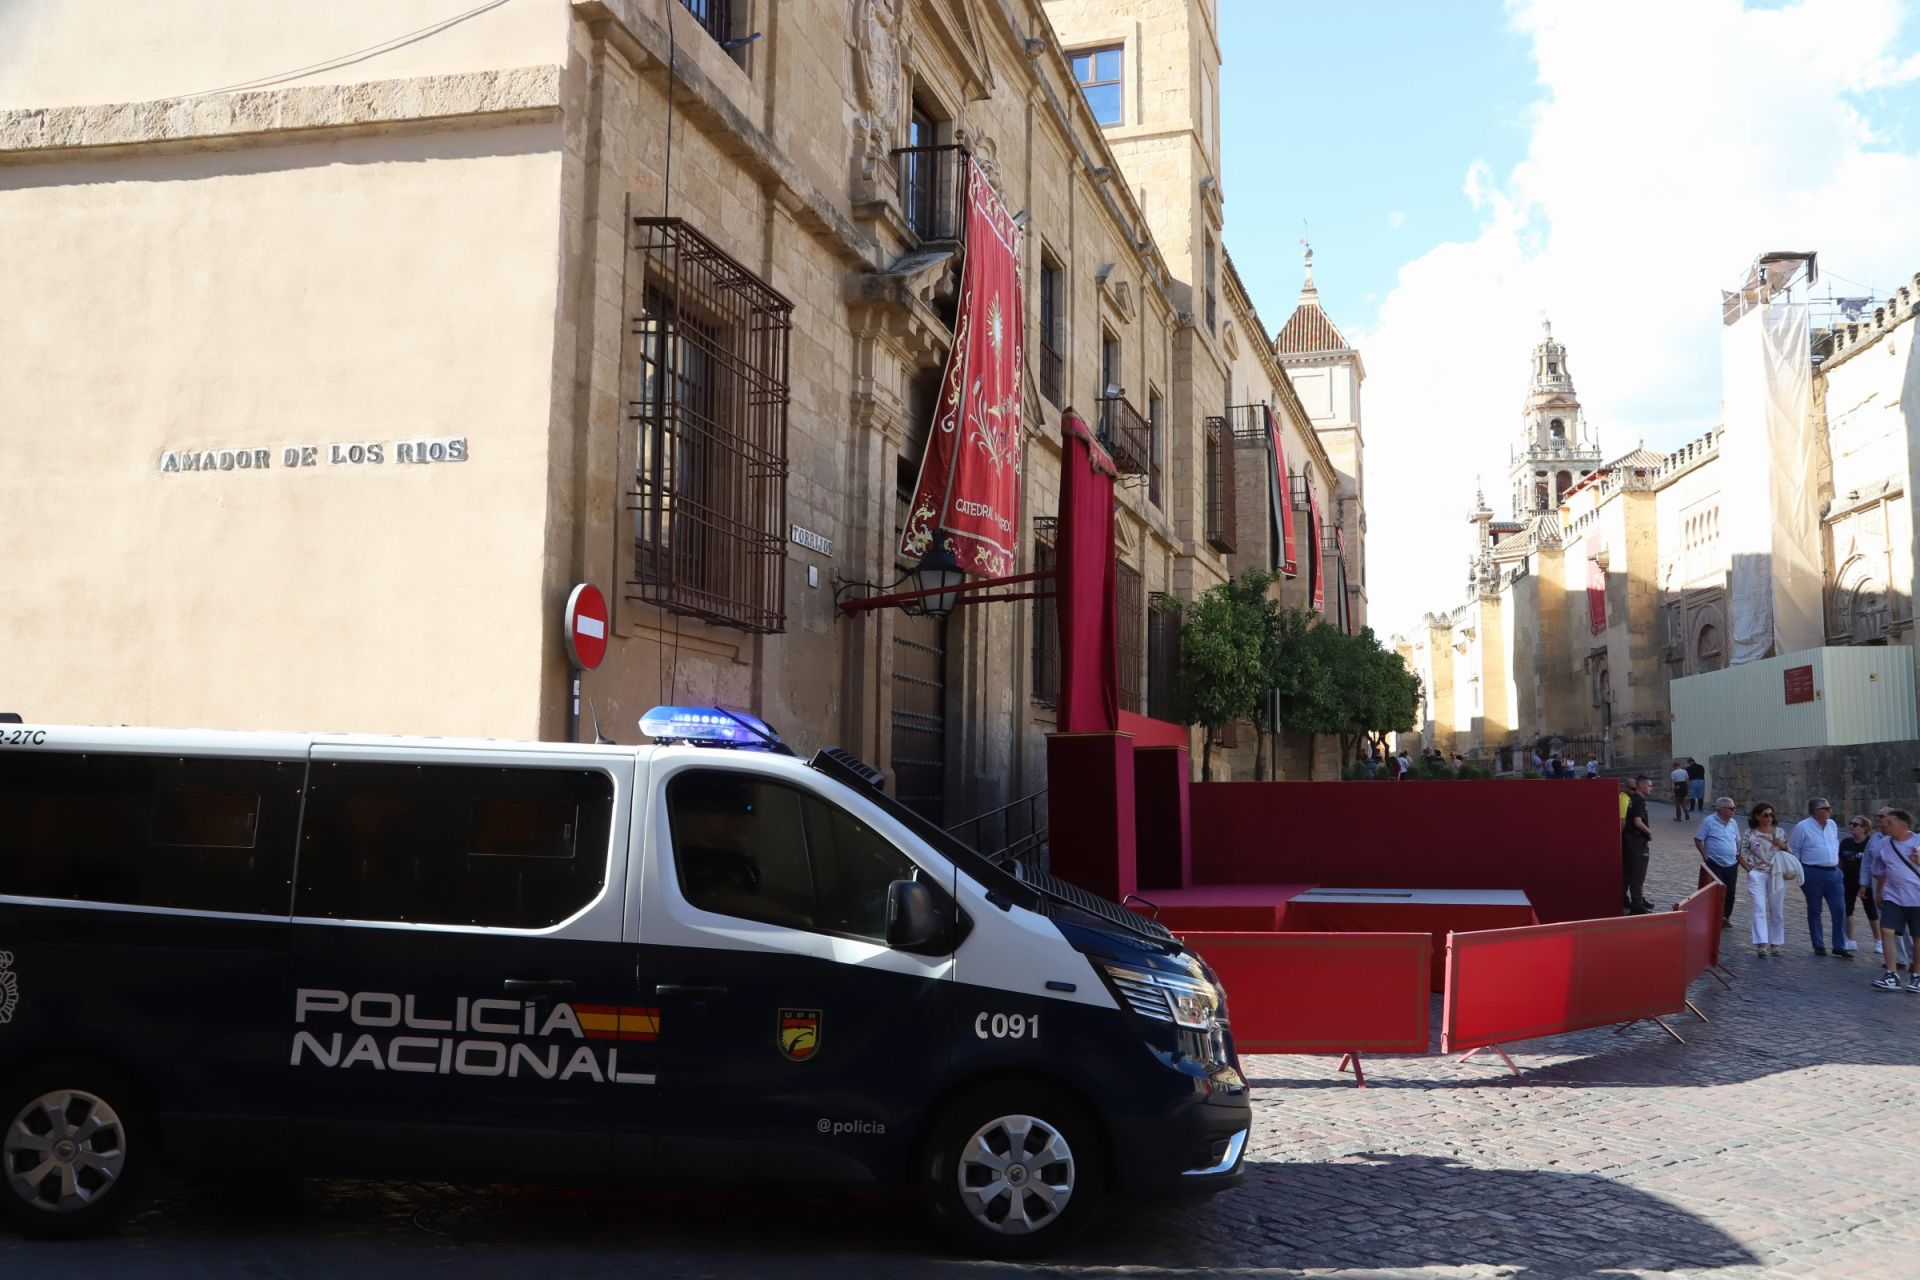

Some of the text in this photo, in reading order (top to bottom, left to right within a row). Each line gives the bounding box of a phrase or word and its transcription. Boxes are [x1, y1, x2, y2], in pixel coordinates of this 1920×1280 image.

[162, 440, 467, 473] AMADOR DE LOS RIOS
[793, 526, 833, 555] TORRIJOS
[991, 1013, 1039, 1039] 091
[290, 1031, 656, 1085] NACIONAL
[817, 1118, 885, 1135] @policia
